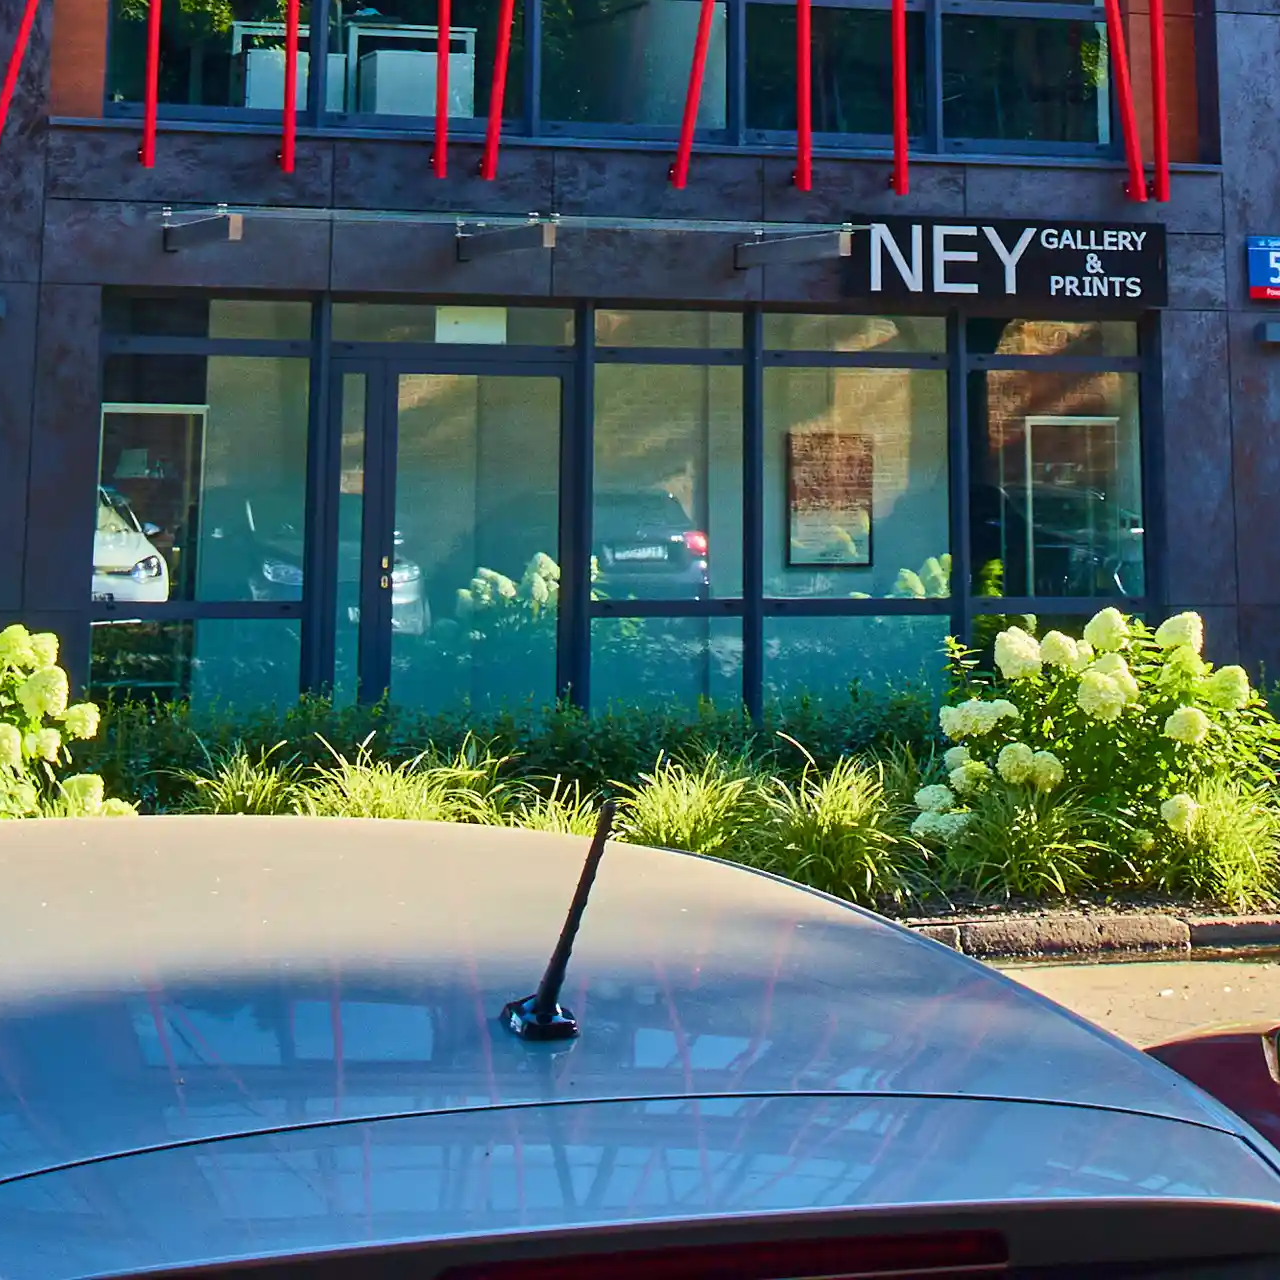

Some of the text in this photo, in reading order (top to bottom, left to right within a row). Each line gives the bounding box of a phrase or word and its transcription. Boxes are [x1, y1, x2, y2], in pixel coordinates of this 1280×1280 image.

[1041, 228, 1147, 252] GALLERY
[869, 222, 1037, 294] NEY
[1086, 252, 1104, 275] &
[1050, 276, 1142, 298] PRINTS
